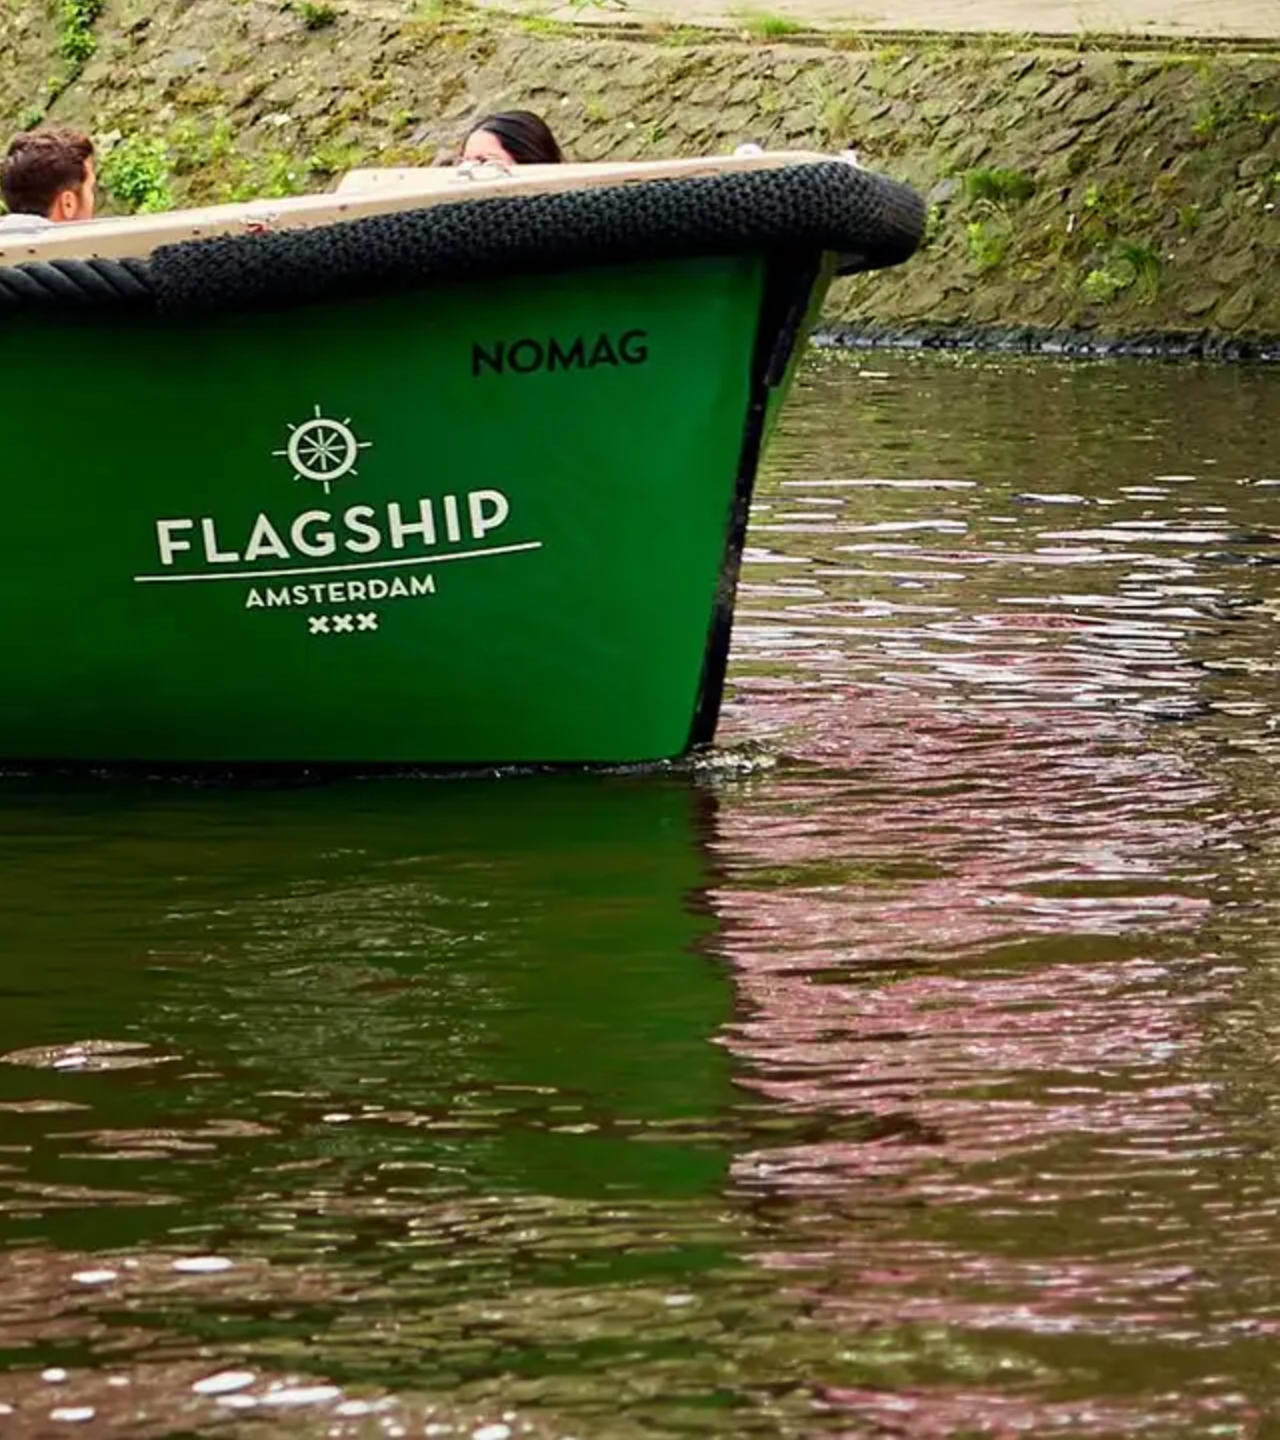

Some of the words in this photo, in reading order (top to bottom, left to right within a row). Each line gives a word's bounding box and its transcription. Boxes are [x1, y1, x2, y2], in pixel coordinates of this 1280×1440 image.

[469, 329, 650, 377] NOMAG
[155, 488, 511, 565] FLAGSHIP
[244, 574, 436, 609] AMSTERDAM
